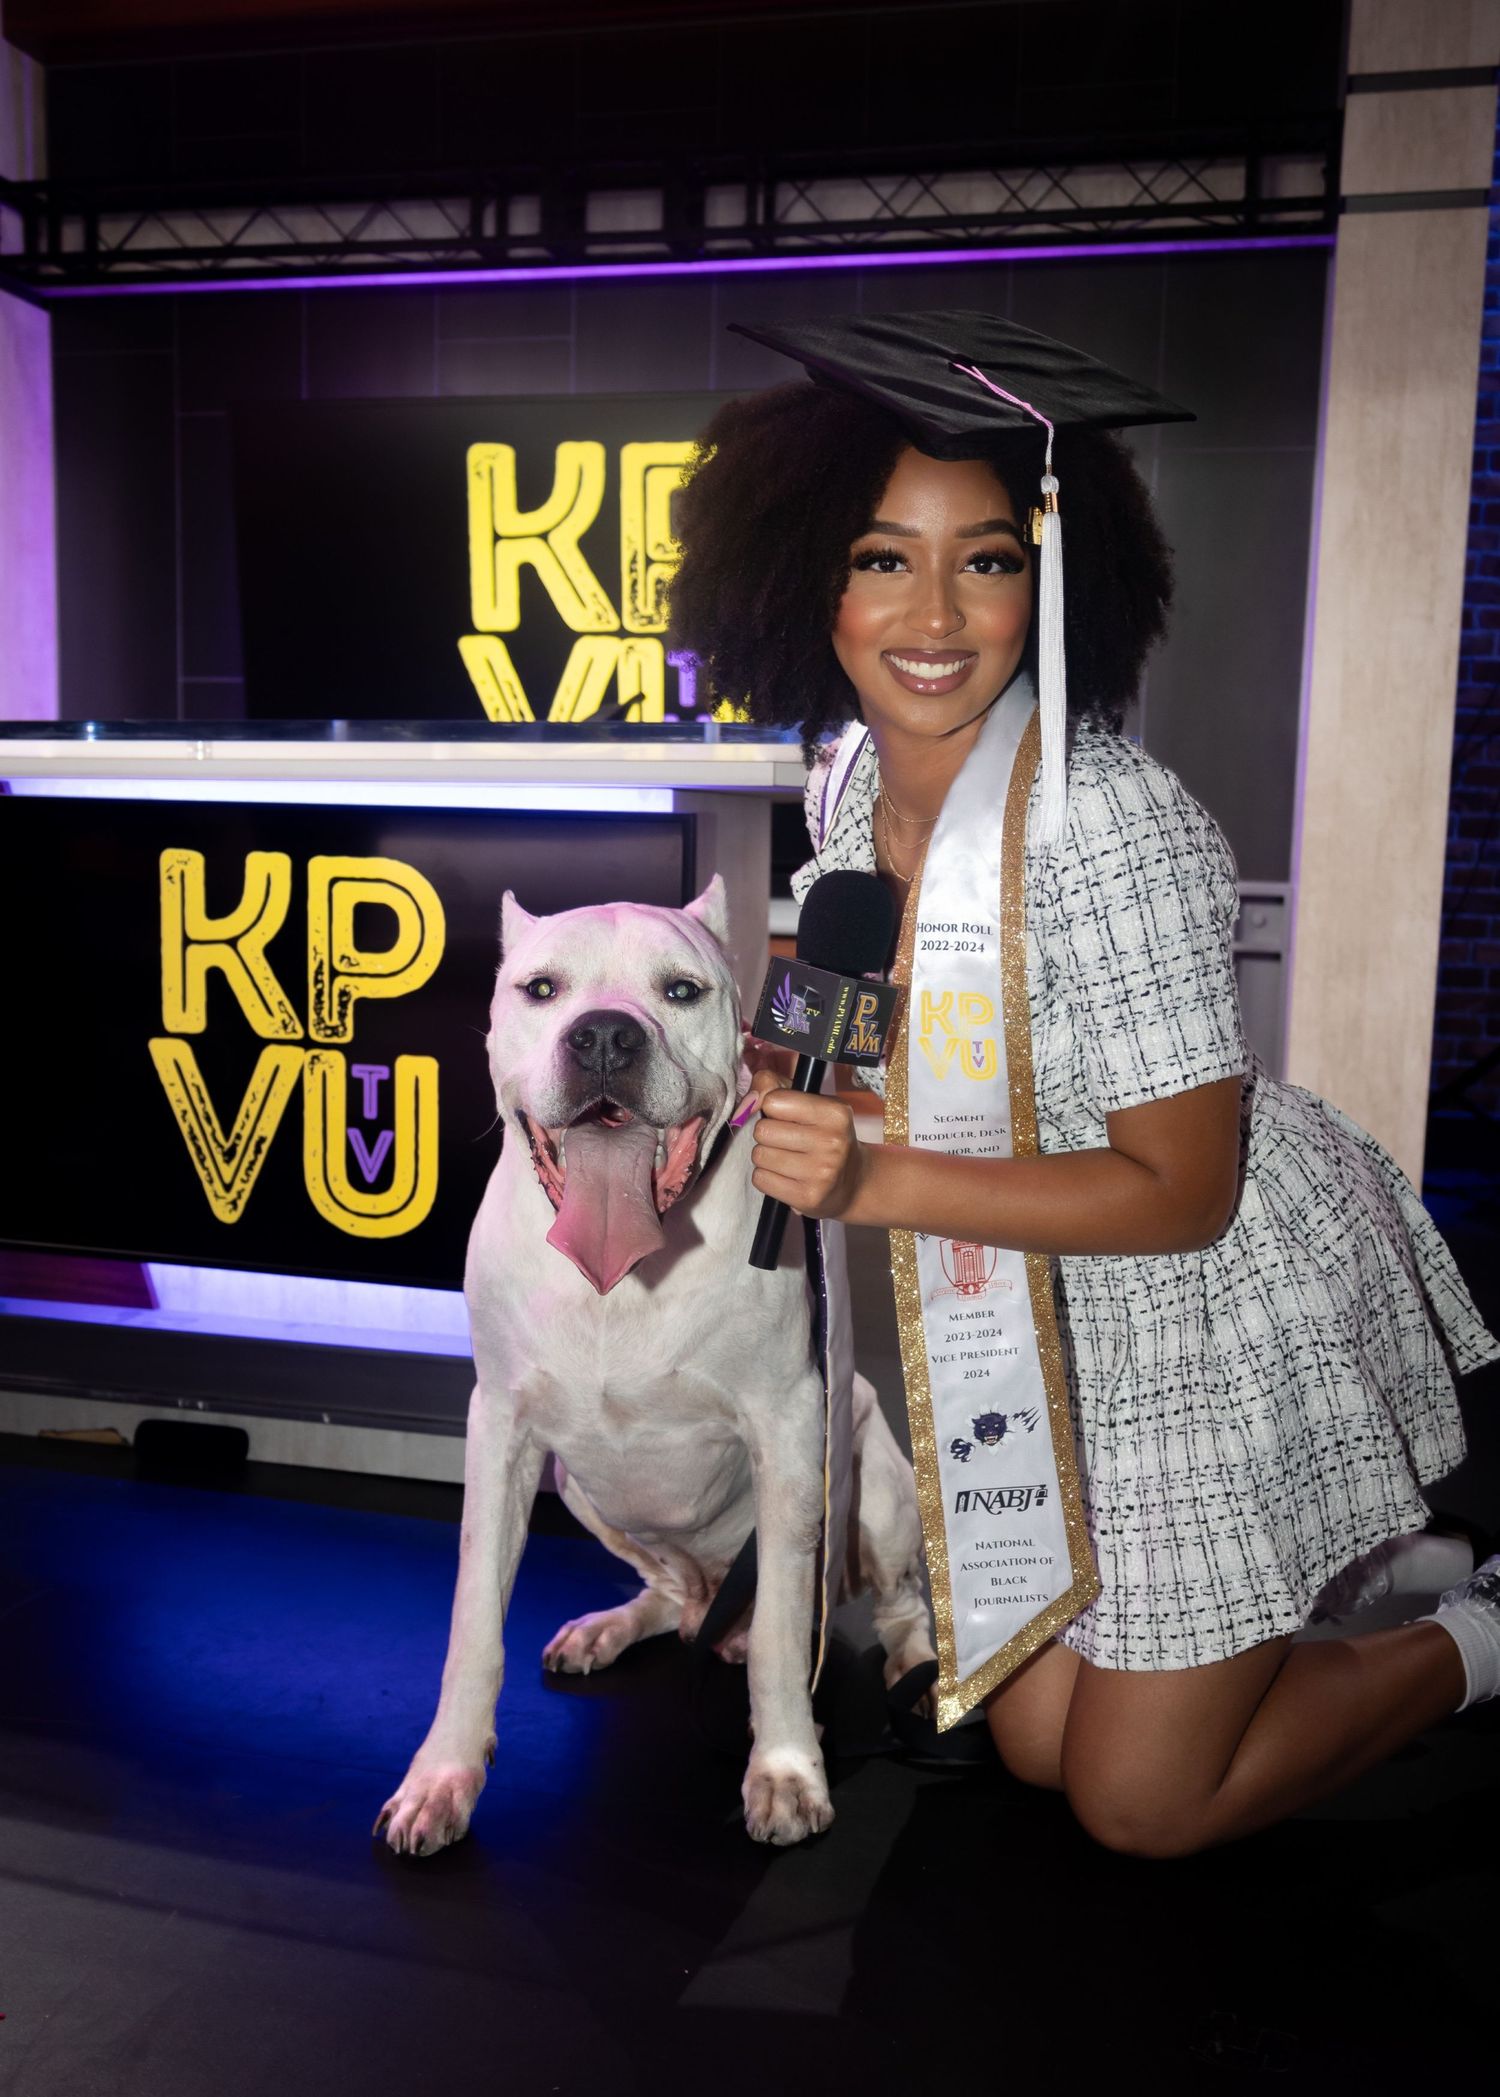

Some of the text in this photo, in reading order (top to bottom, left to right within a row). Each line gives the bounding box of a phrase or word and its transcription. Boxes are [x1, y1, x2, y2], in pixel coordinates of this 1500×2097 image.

[160, 848, 446, 1044] KP
[920, 940, 985, 952] 2022-2024
[920, 990, 994, 1036] KP
[917, 1036, 998, 1082] VU
[148, 1037, 439, 1239] VU
[944, 1328, 1003, 1343] 2023-2024
[963, 1369, 990, 1380] 2024
[971, 1488, 1035, 1515] NABJ
[1039, 1556, 1055, 1566] OF
